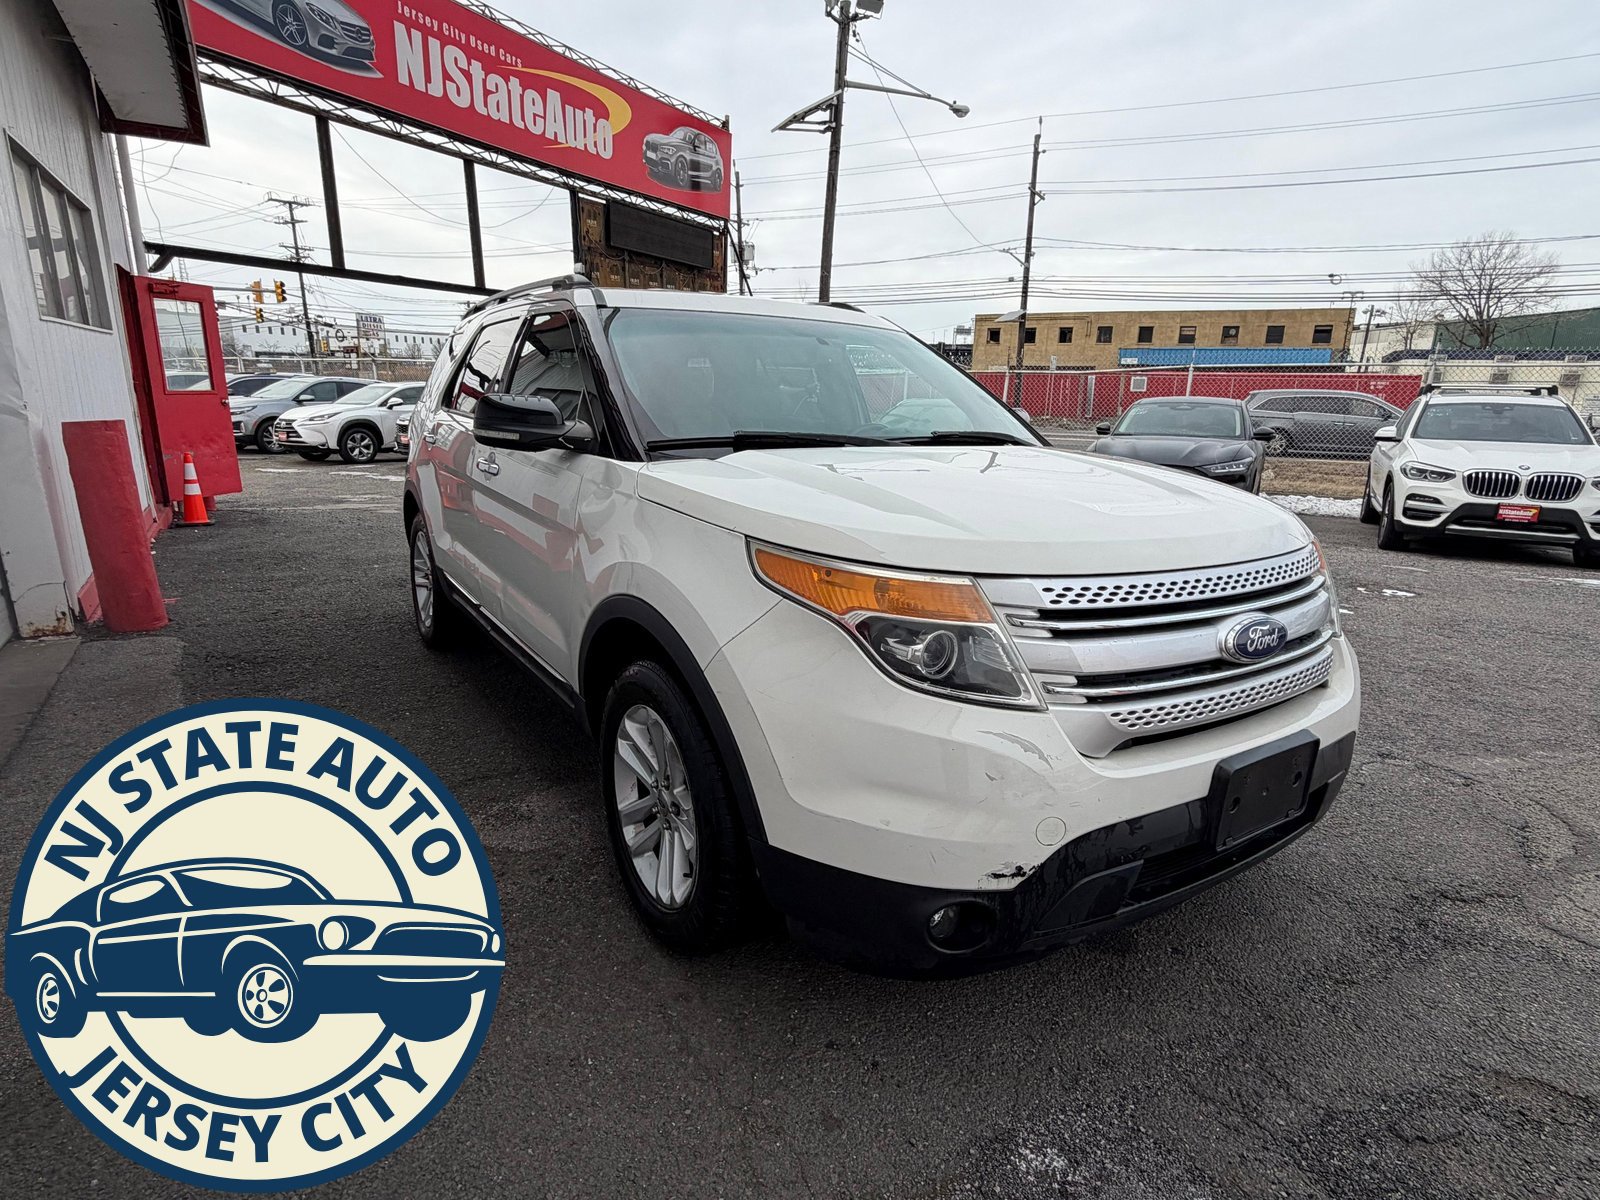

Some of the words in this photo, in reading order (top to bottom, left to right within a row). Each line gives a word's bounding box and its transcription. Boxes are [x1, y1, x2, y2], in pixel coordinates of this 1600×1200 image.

[397, 0, 439, 31] Jersey
[442, 22, 466, 44] City
[469, 34, 496, 57] Used
[499, 48, 523, 68] Cars
[393, 20, 613, 160] NJStateAuto
[1247, 624, 1280, 652] Ford
